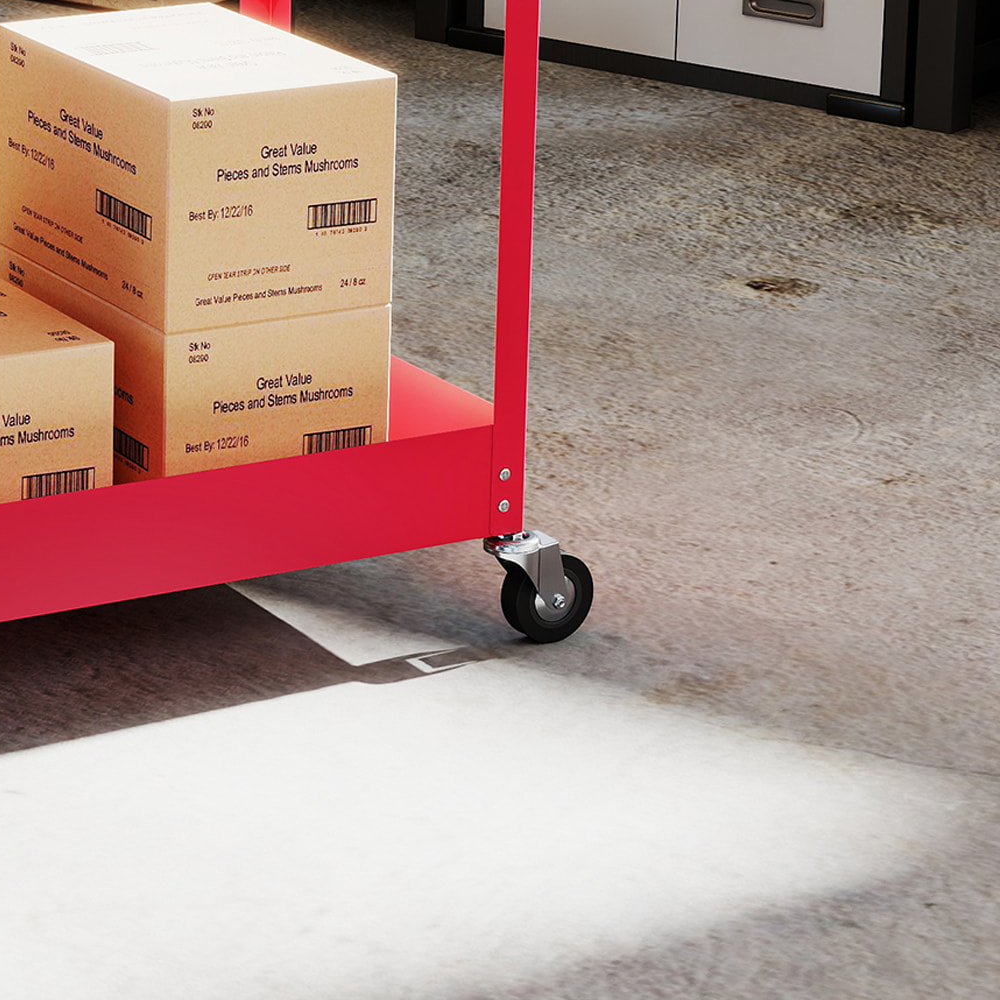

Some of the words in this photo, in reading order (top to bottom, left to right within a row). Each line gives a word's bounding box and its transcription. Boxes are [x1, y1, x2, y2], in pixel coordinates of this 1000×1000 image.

[59, 108, 80, 129] Great
[81, 118, 103, 140] Value
[27, 109, 52, 132] Pieces
[53, 124, 67, 141] and
[68, 130, 92, 152] Stems
[93, 142, 137, 175] Mushrooms
[260, 144, 288, 160] Great
[289, 142, 318, 156] Value
[216, 168, 249, 183] Pieces
[251, 164, 270, 179] and
[271, 162, 302, 177] Stems
[304, 157, 359, 174] Mushrooms
[188, 210, 206, 222] Best
[220, 204, 254, 219] 12/22/16
[195, 297, 212, 307] Great
[213, 294, 231, 304] Value
[232, 292, 253, 302] Pieces
[254, 289, 266, 299] and
[267, 288, 287, 298] Stems
[288, 283, 323, 295] Mushrooms
[256, 375, 283, 391] Great
[284, 372, 313, 387] Value
[212, 400, 245, 415] Pieces
[247, 395, 266, 410] and
[267, 393, 297, 408] Stems
[299, 385, 354, 404] Mushrooms
[1, 412, 31, 427] Value
[17, 426, 75, 445] Mushrooms
[185, 442, 202, 454] Best
[216, 435, 249, 450] 12/22/16
